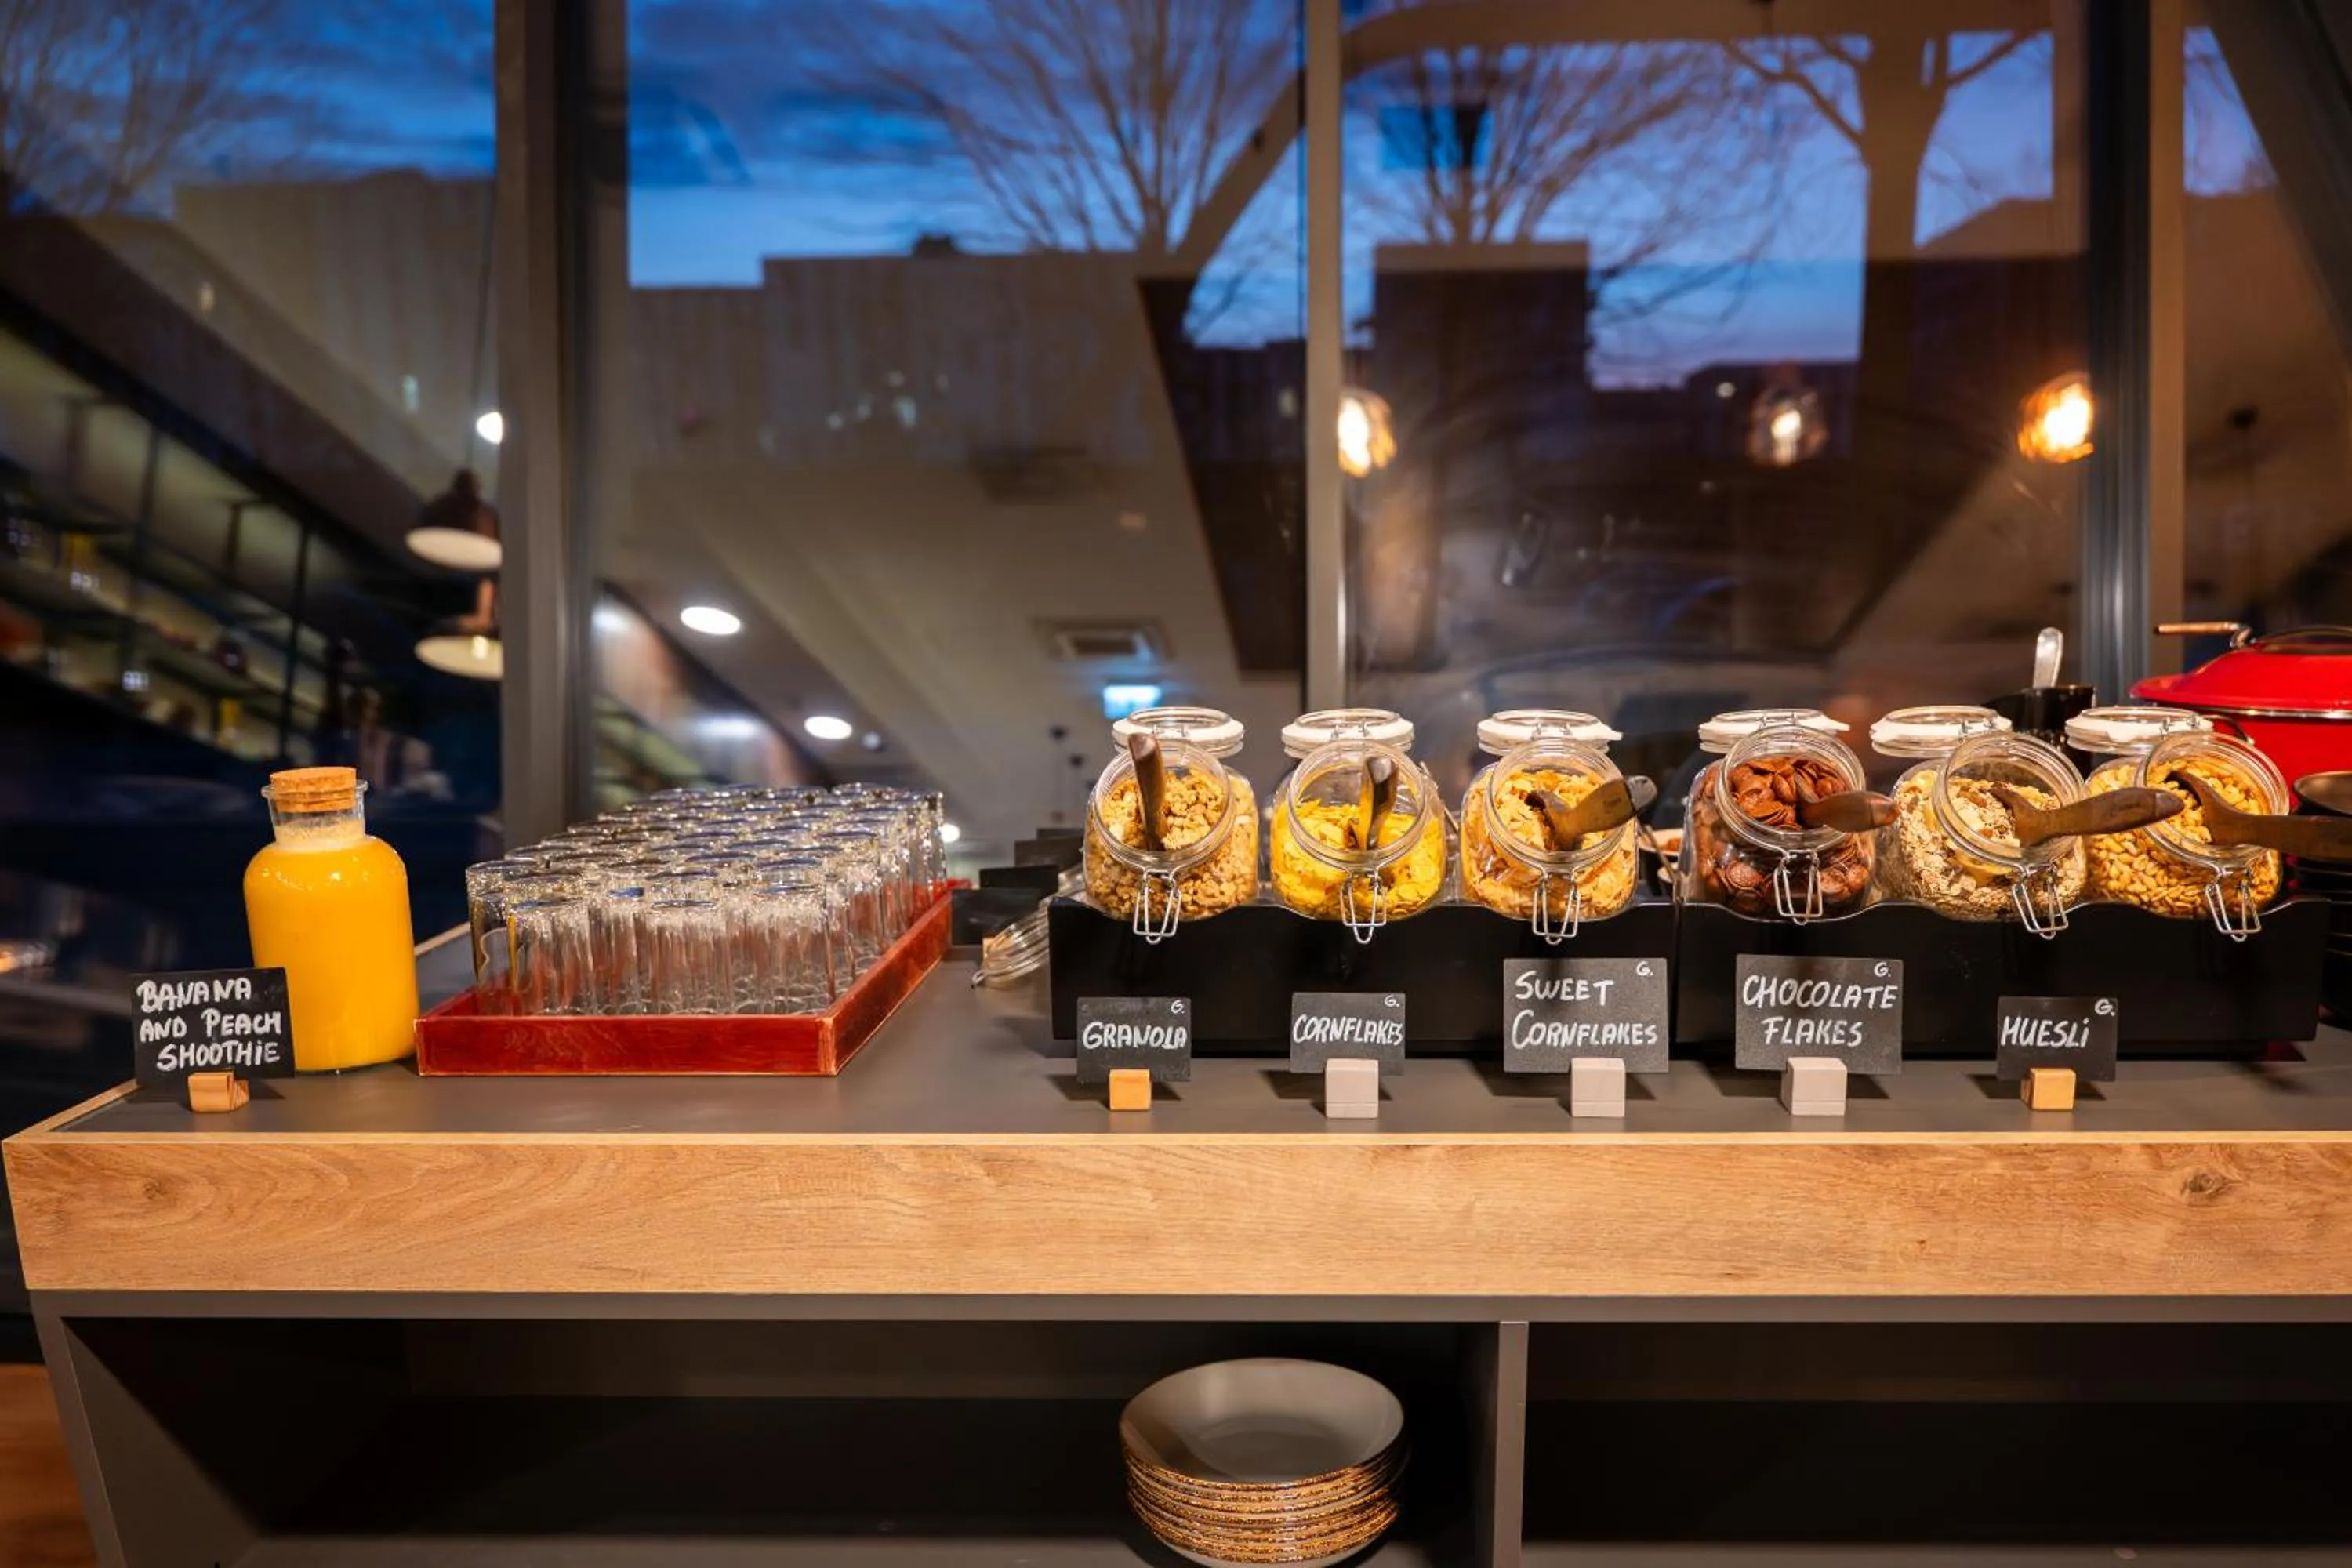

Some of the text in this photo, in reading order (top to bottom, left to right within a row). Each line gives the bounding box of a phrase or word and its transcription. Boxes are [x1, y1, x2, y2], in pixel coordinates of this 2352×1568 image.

[136, 977, 252, 1014] BANANA
[1515, 970, 1614, 1006] SWEET
[1743, 975, 1898, 1009] CHOCOLATE
[140, 1007, 281, 1043] AND PEACH
[1082, 1021, 1188, 1050] GRANOLA
[1293, 1014, 1403, 1046] CORNFLAKES
[1512, 1009, 1658, 1049] CORNFLAKES
[1761, 1016, 1863, 1047] FLAKES
